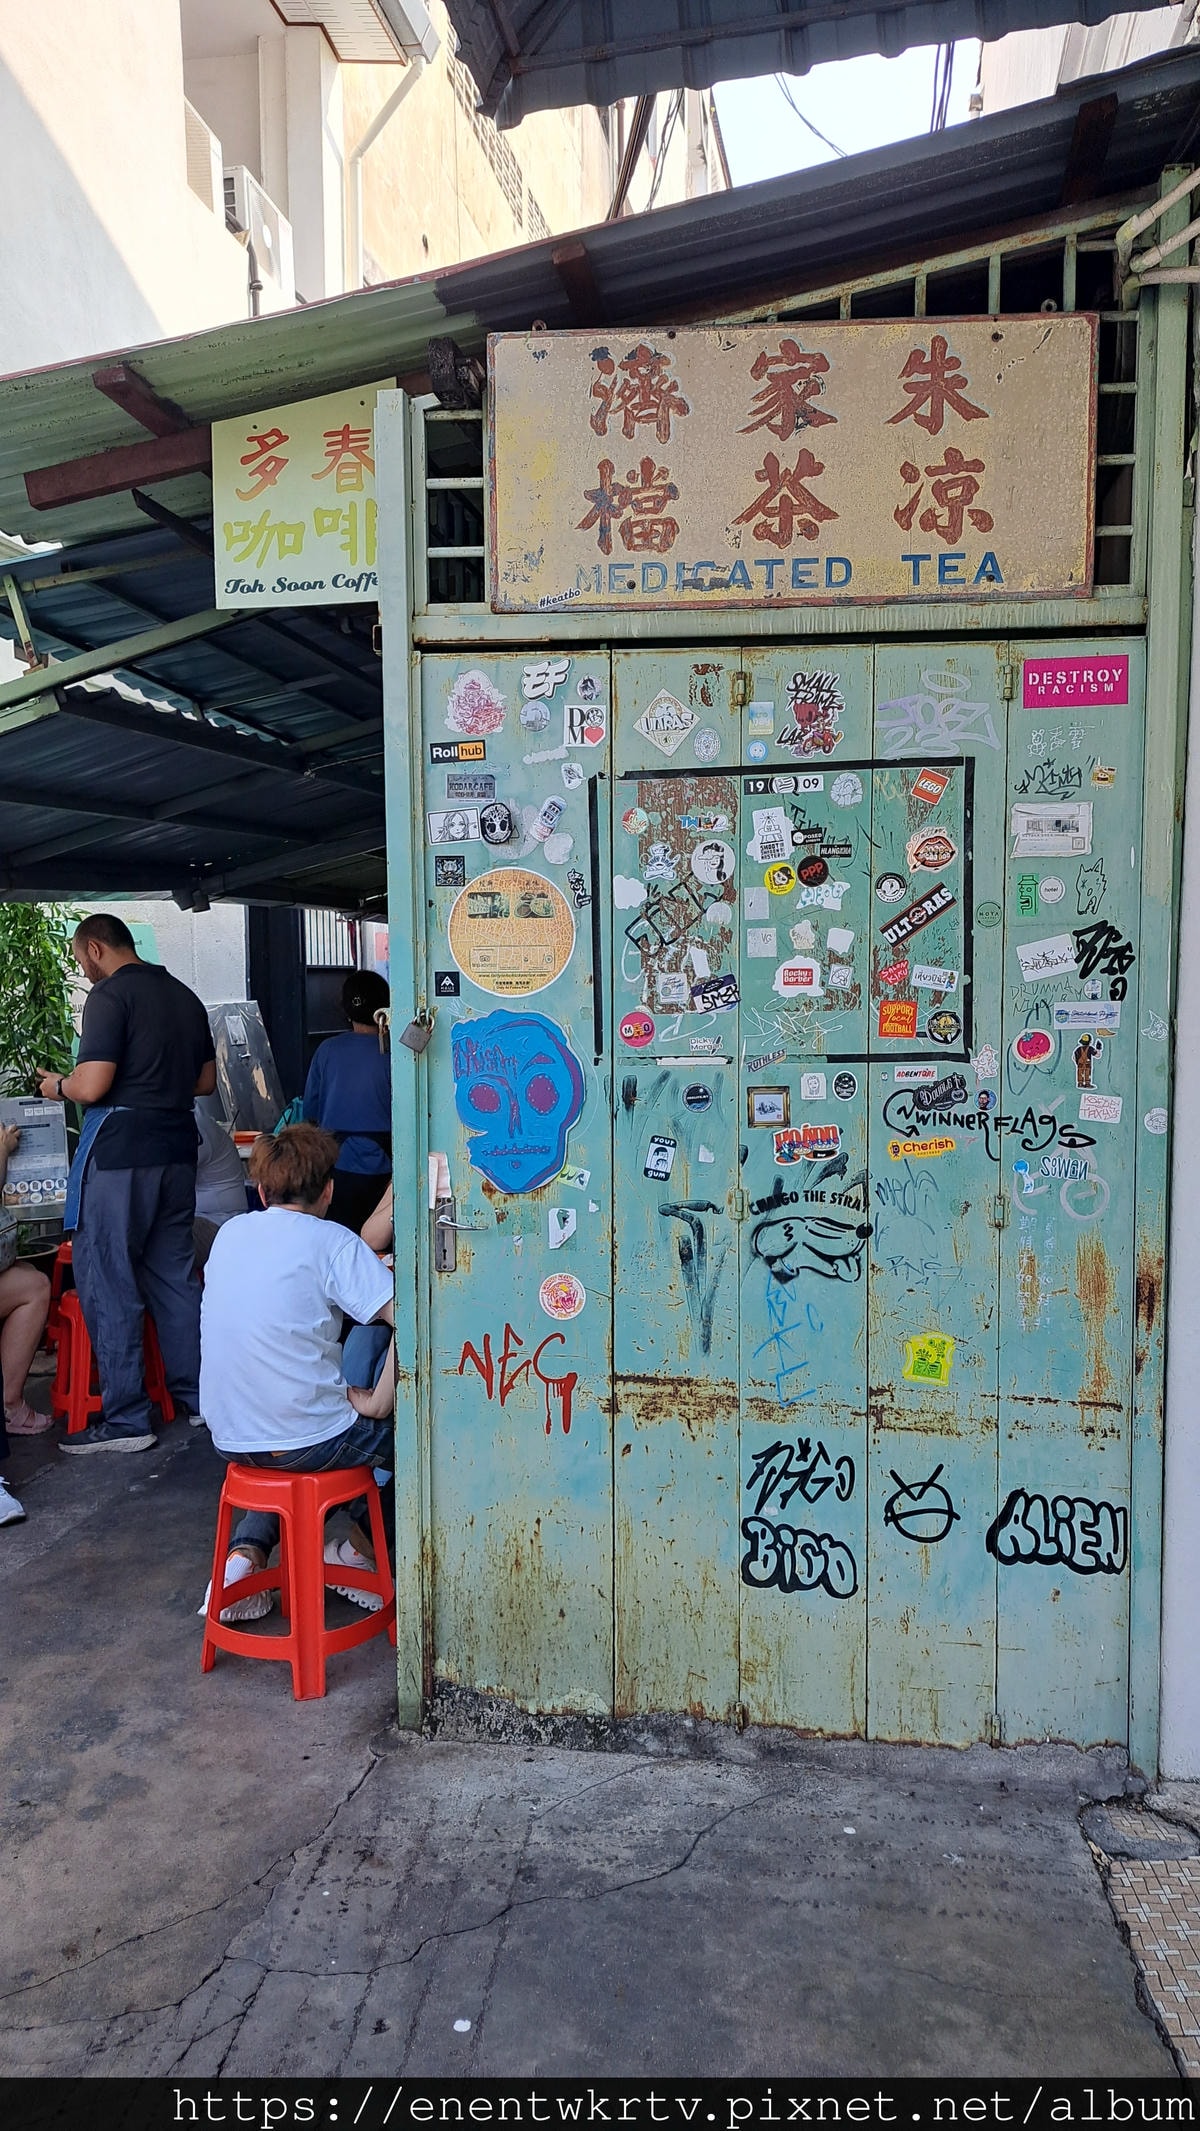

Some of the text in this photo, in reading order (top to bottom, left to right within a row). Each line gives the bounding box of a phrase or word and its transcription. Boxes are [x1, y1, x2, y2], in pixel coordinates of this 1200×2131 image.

[575, 551, 1004, 595] MEDICATED TEA
[225, 578, 266, 594] Toh
[272, 577, 326, 593] Soon
[538, 588, 582, 608] #keatbo
[787, 672, 839, 692] SMALL
[1028, 668, 1123, 686] DESTROY
[1038, 683, 1114, 695] RACISM
[749, 778, 819, 792] 19 09
[919, 778, 942, 794] LEGO
[801, 862, 823, 879] PPP
[882, 961, 908, 978] SALON
[882, 1004, 915, 1017] SUPPORT
[882, 1022, 913, 1034] FOOTBALL
[654, 1136, 675, 1146] your
[903, 1139, 954, 1153] Cherish
[647, 1169, 666, 1179] gum
[803, 1190, 826, 1203] THE
